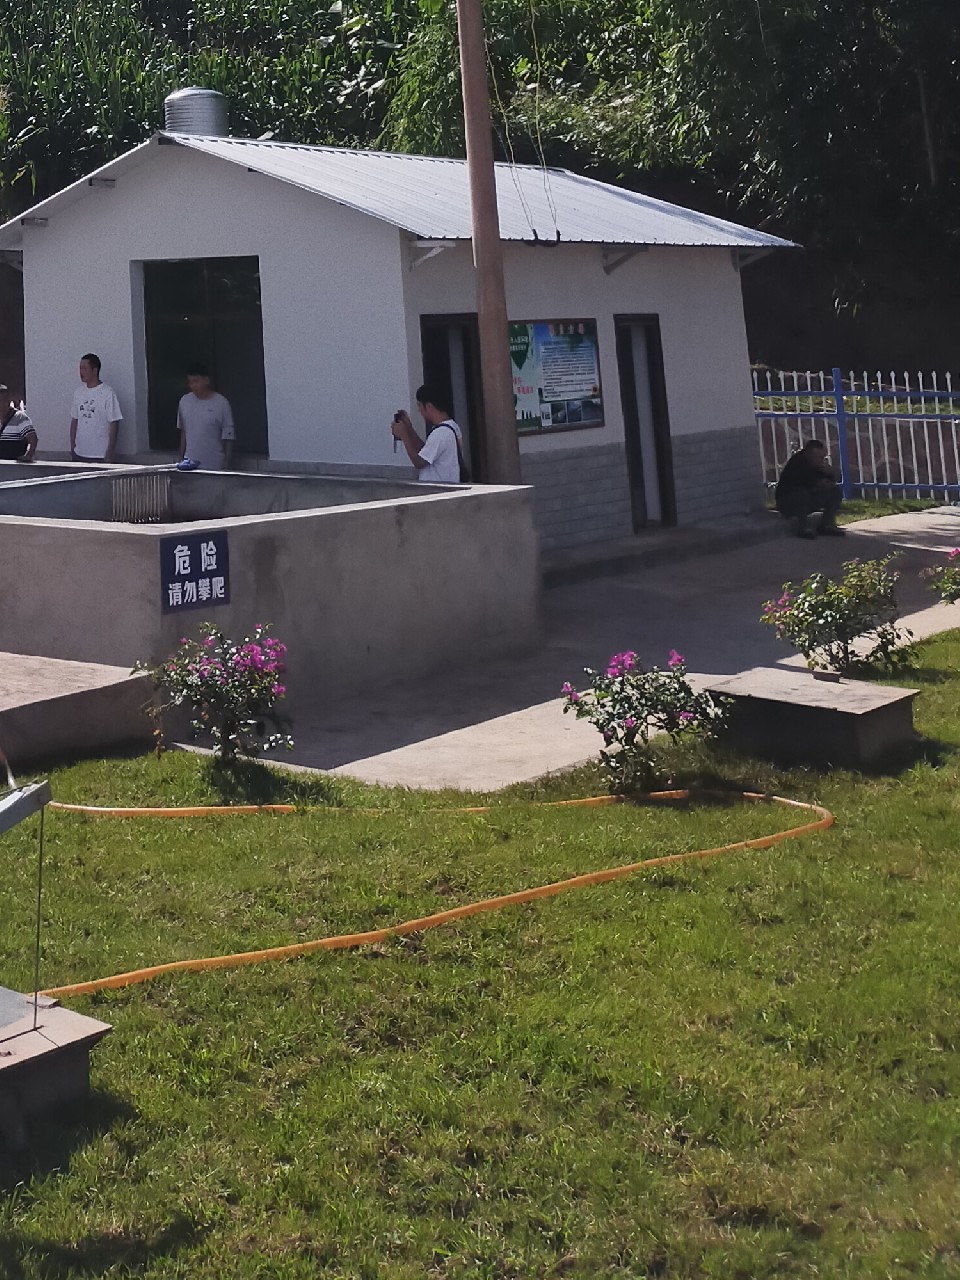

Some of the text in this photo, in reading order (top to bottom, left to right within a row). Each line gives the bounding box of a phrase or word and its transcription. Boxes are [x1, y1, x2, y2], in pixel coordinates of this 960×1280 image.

[173, 540, 217, 576] 危险
[168, 576, 225, 607] 请勿攀爬
